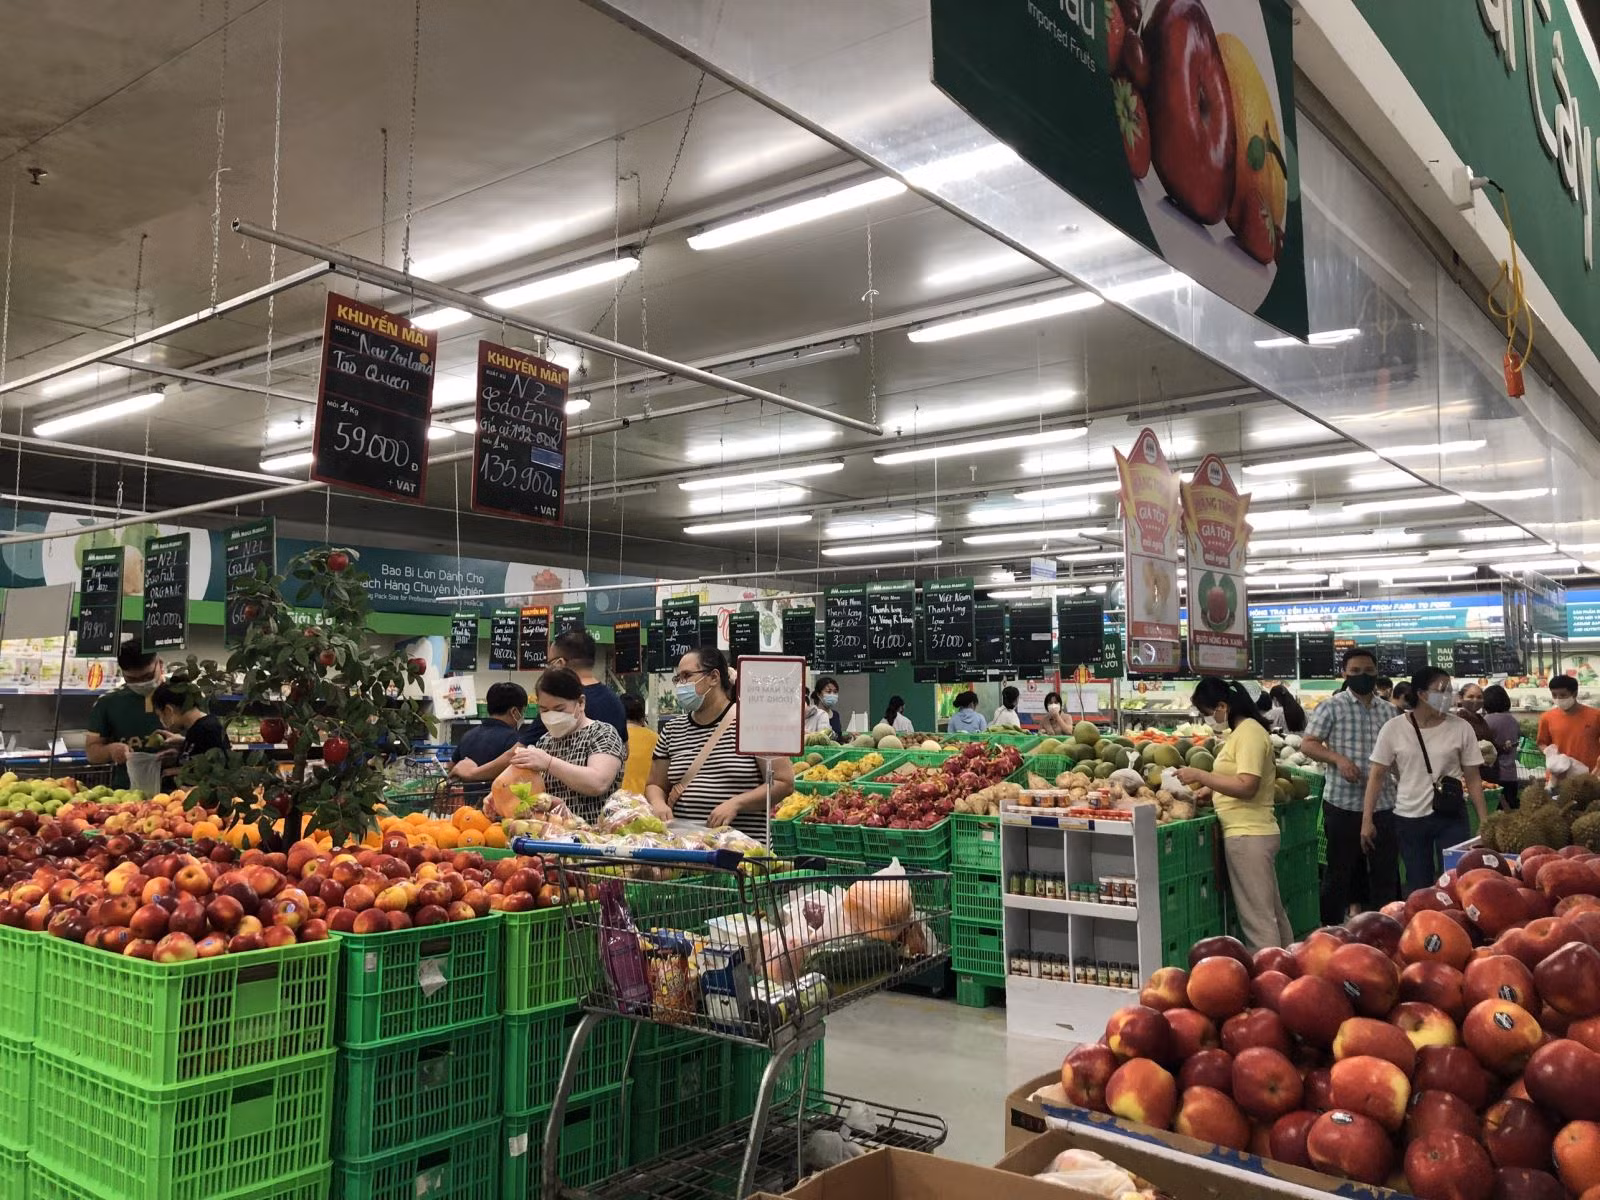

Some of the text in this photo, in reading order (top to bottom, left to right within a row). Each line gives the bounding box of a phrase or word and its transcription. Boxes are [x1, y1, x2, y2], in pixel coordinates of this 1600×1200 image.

[1028, 0, 1096, 73] Imported Fruits
[337, 304, 428, 347] KHUYẾN MÃI
[359, 334, 388, 359] New
[333, 350, 409, 391] Táo Queen
[487, 349, 562, 385] KHUYẾN MÃI
[340, 401, 349, 412] 1
[334, 422, 410, 467] 59.000
[493, 436, 501, 449] 1
[480, 453, 552, 495] 135.900
[396, 480, 416, 493] VAT
[540, 505, 557, 516] VAT
[1202, 523, 1231, 541] GIÁ TỐT
[381, 564, 402, 576] Bao
[418, 568, 436, 579] Lớn
[466, 572, 485, 584] Cho
[361, 578, 381, 589] ách
[384, 579, 410, 594] Hàng
[414, 581, 450, 597] Chuyên
[1338, 605, 1370, 613] QUALITY
